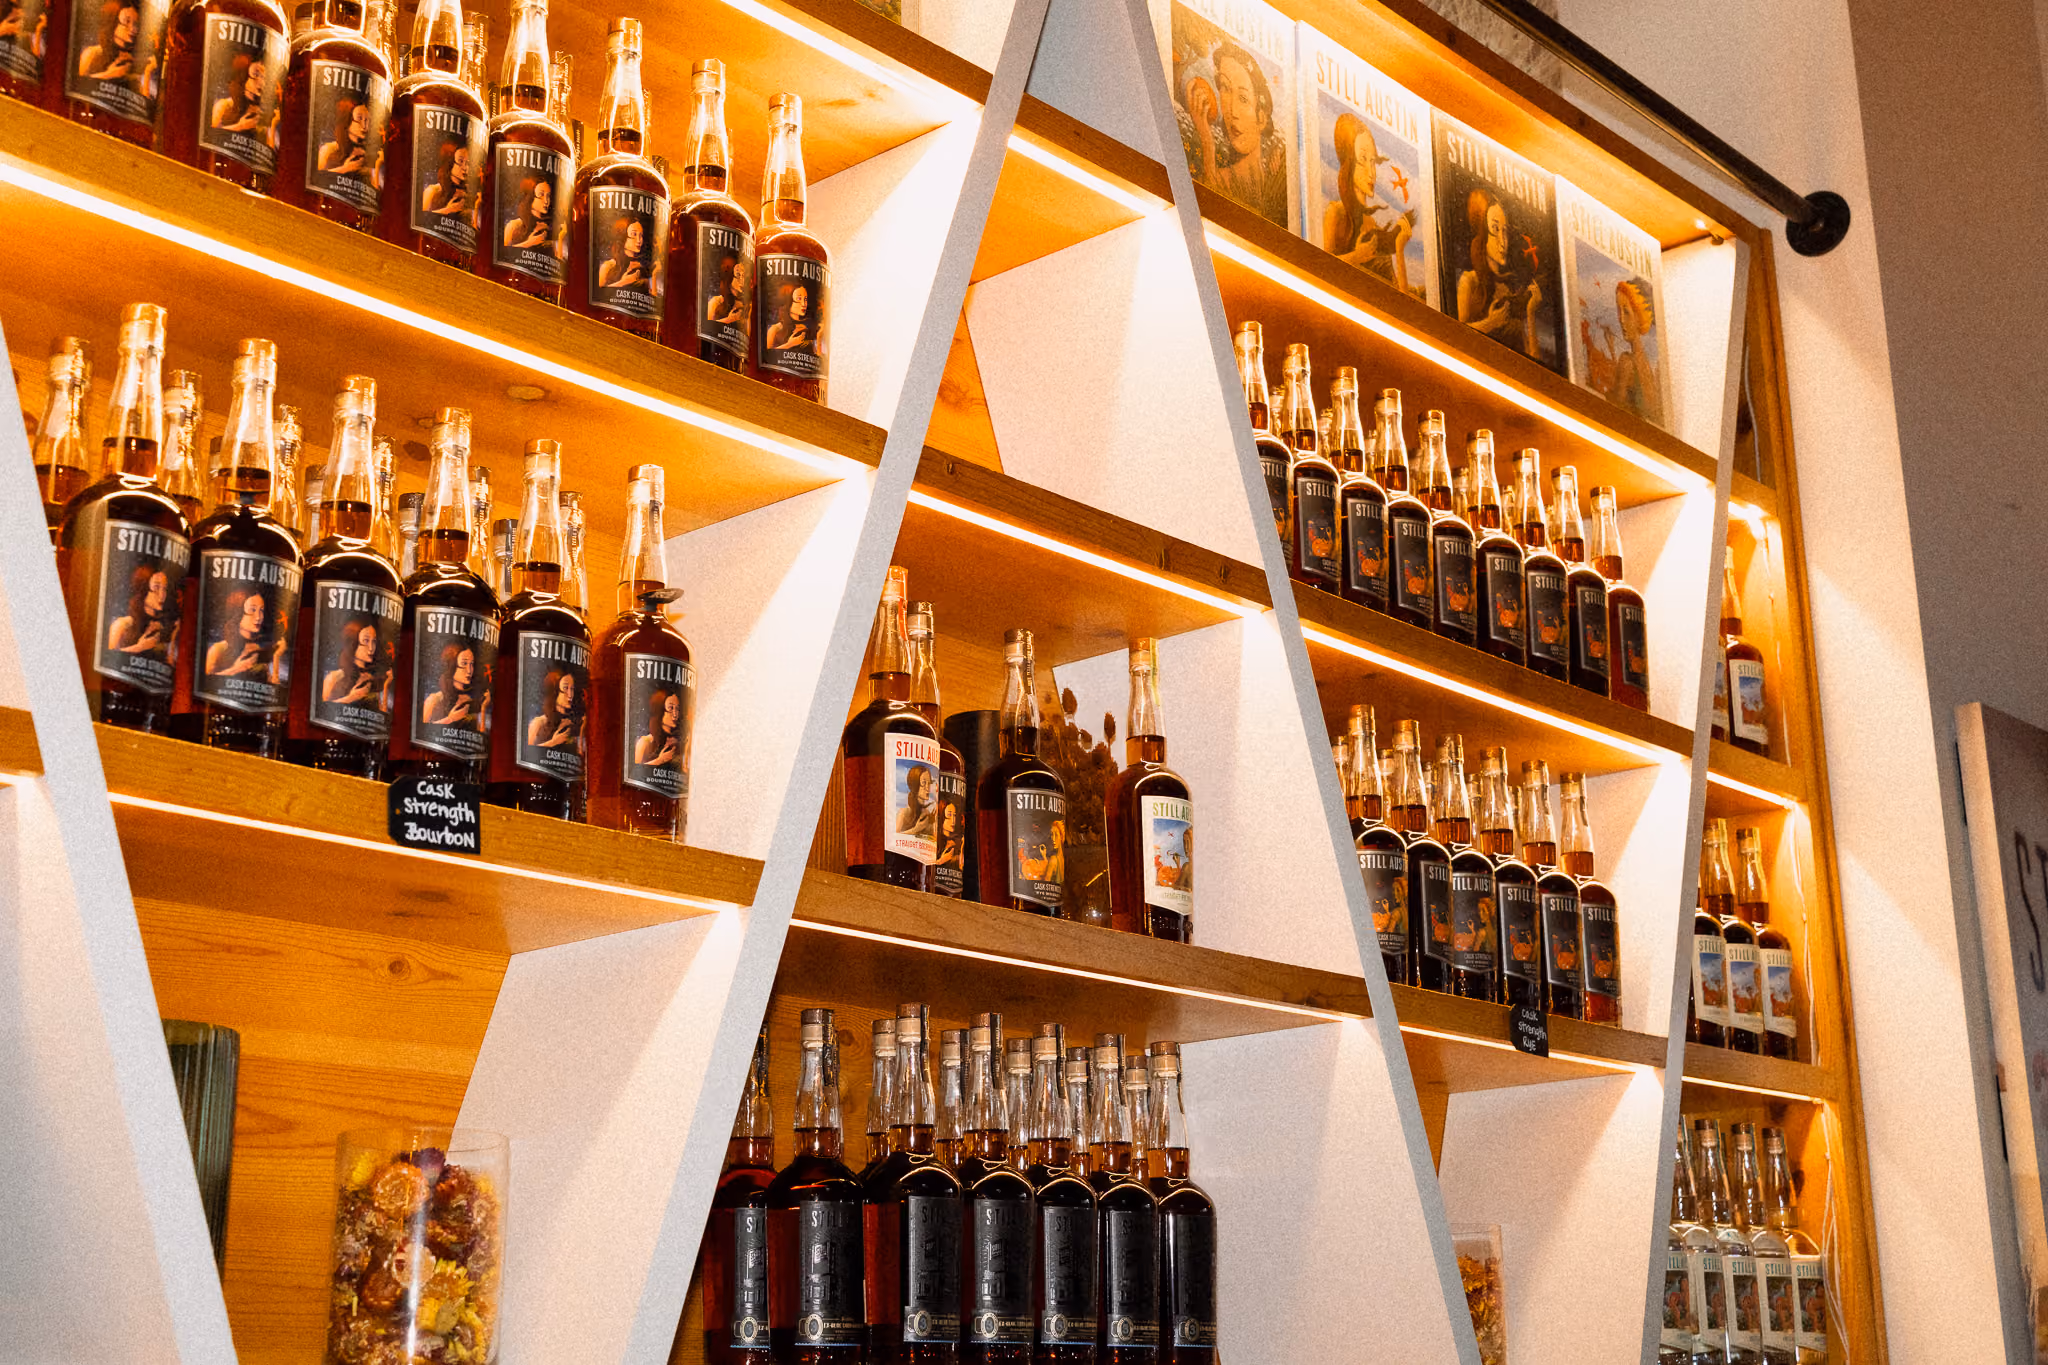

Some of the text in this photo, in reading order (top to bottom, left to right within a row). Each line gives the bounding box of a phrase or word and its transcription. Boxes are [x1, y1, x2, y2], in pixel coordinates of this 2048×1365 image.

[218, 20, 259, 48] STILL
[323, 67, 362, 92] STILL
[1317, 50, 1418, 144] STILL AUSTIN
[426, 111, 463, 136] STILL
[506, 149, 543, 170] STILL
[1447, 131, 1548, 215] STILL AUSTIN
[599, 191, 634, 211] STILL
[440, 216, 455, 229] CASK
[709, 228, 739, 251] STILL
[1571, 201, 1653, 279] STILL AUSTIN
[521, 250, 537, 261] CASK
[766, 259, 799, 276] STILL
[616, 289, 631, 299] CASK
[783, 351, 797, 361] CASK
[1306, 482, 1330, 498] STILL
[1355, 503, 1379, 519] STILL
[1402, 522, 1425, 539] STILL
[117, 528, 161, 558] STILL
[1444, 541, 1467, 556] STILL
[1494, 558, 1516, 574] STILL
[212, 557, 300, 595] STILL AUSTIN
[1535, 576, 1558, 591] STILL
[328, 588, 369, 612] STILL
[427, 613, 467, 636] STILL
[530, 639, 567, 661] STILL
[637, 660, 674, 683] STILL
[442, 727, 458, 738] CASK
[896, 741, 925, 760] STILL
[652, 768, 667, 778] CASK
[1016, 793, 1046, 810] STILL
[404, 796, 476, 826] Strength
[1152, 802, 1180, 818] STILL
[1360, 854, 1388, 870] STILL
[937, 867, 949, 876] CASK
[1033, 882, 1045, 890] CASK
[1507, 888, 1531, 903] STILL
[1550, 898, 1572, 913] STILL
[1588, 907, 1611, 922] STILL
[1699, 940, 1718, 953] STILL
[1728, 948, 1750, 961] STILL
[1766, 950, 1786, 965] STILL
